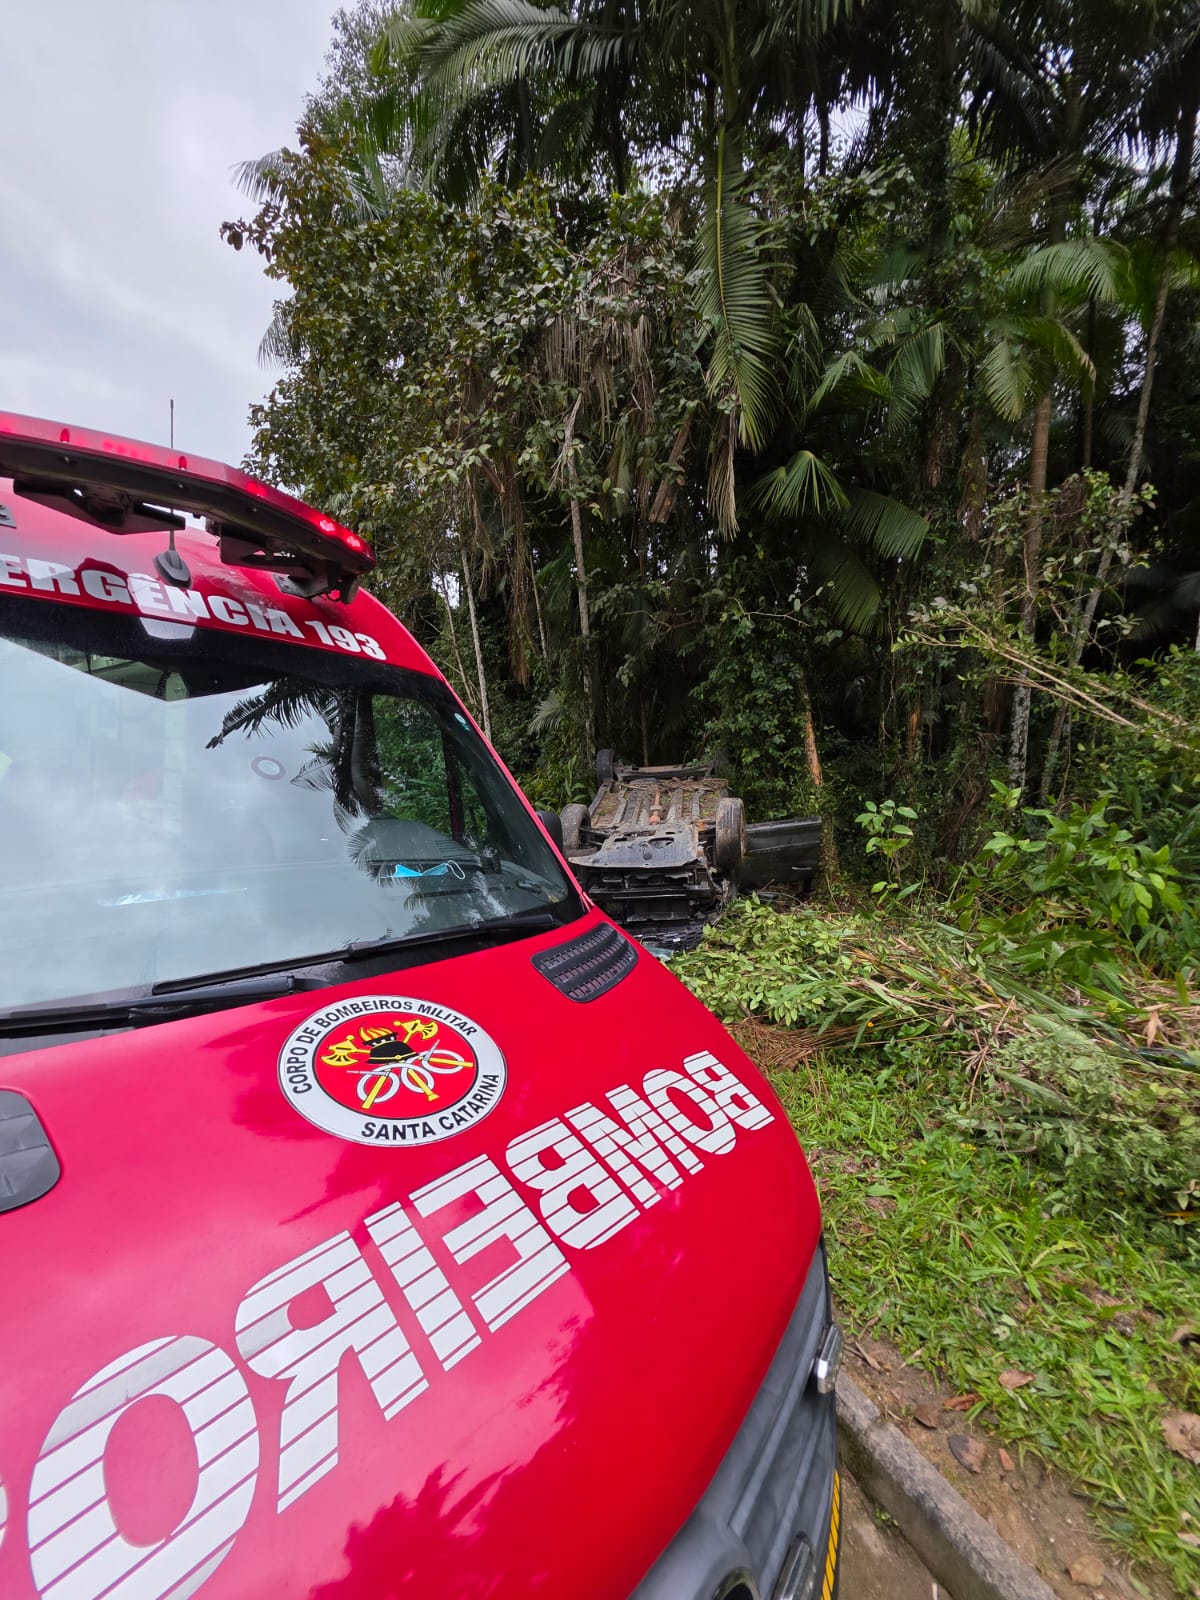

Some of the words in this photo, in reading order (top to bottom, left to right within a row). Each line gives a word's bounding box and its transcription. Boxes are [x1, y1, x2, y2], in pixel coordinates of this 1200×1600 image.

[304, 620, 388, 661] 193
[287, 1047, 313, 1094] CORPO
[302, 1027, 321, 1045] DE
[319, 999, 414, 1029] BOMBEIROS
[418, 1003, 478, 1036] MILITAR
[361, 1122, 437, 1141] SANTA
[438, 1073, 500, 1130] CATARINA
